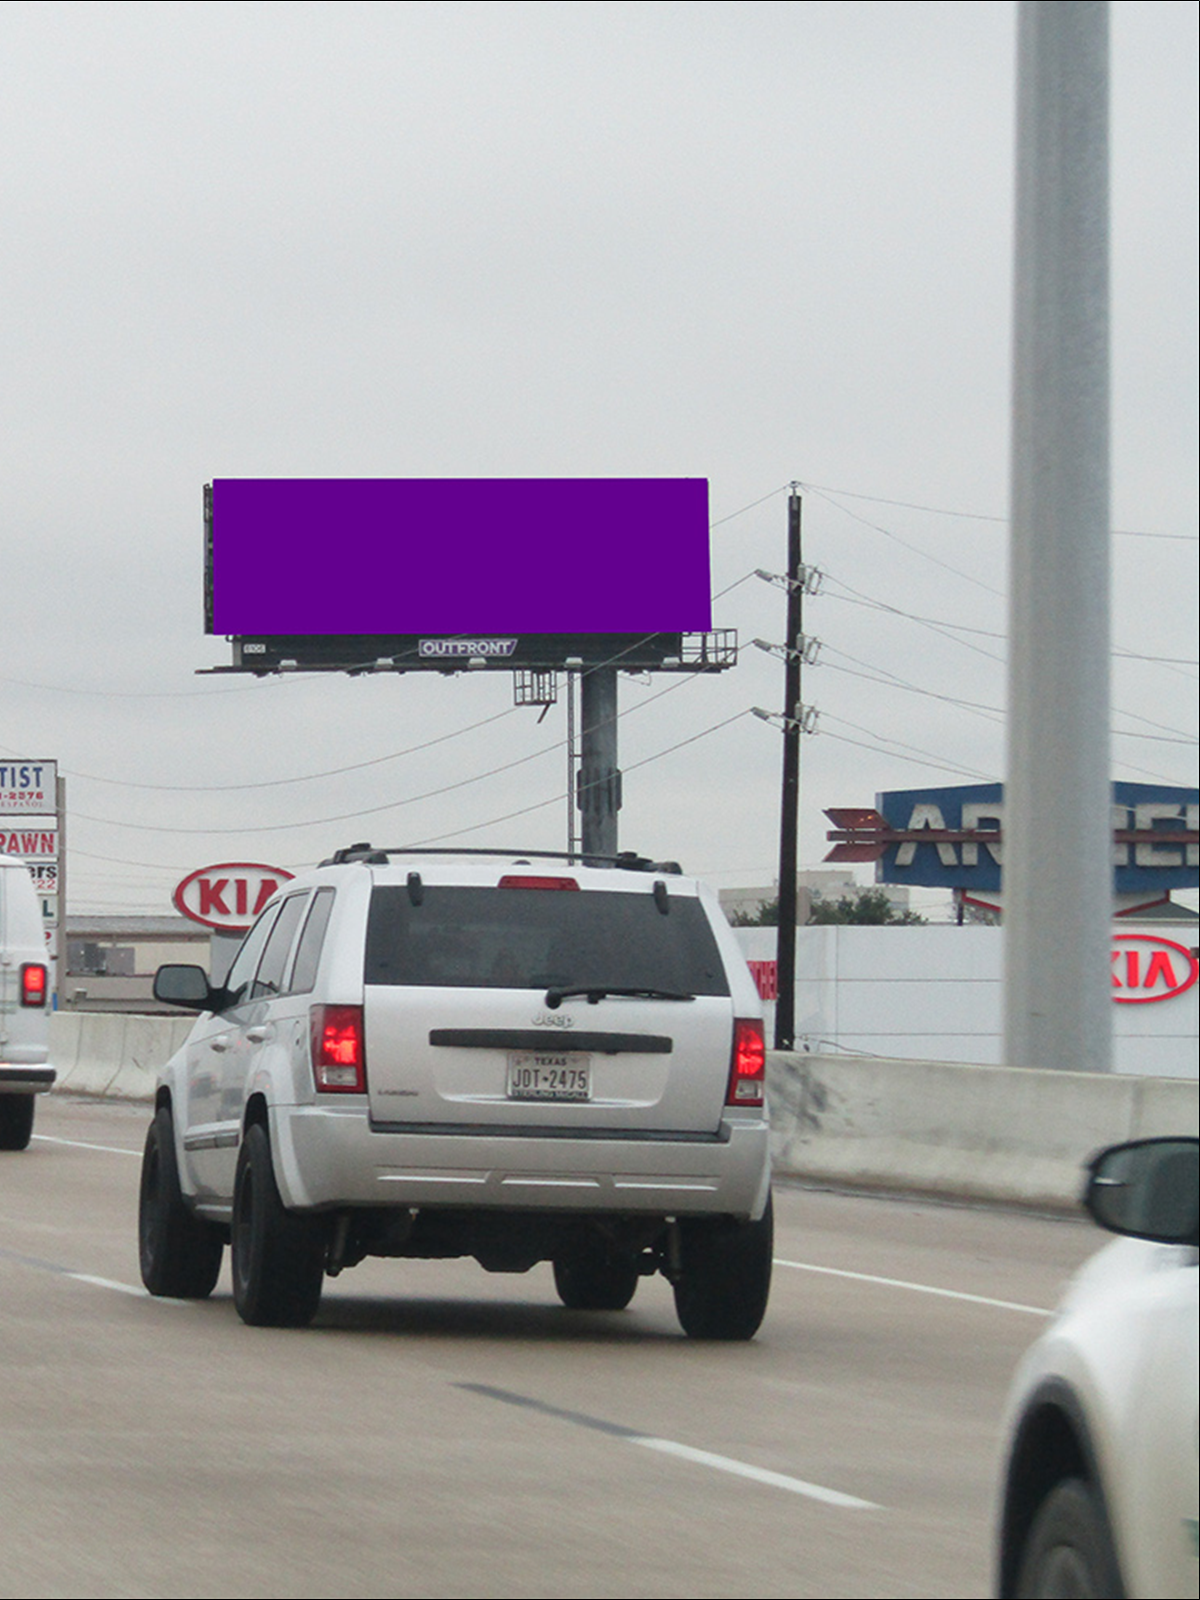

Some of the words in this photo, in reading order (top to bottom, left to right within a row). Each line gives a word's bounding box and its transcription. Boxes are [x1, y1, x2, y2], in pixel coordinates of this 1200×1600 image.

[423, 641, 511, 655] OUTFRONT
[532, 1012, 575, 1029] Jeep
[534, 1057, 567, 1066] TEXAS
